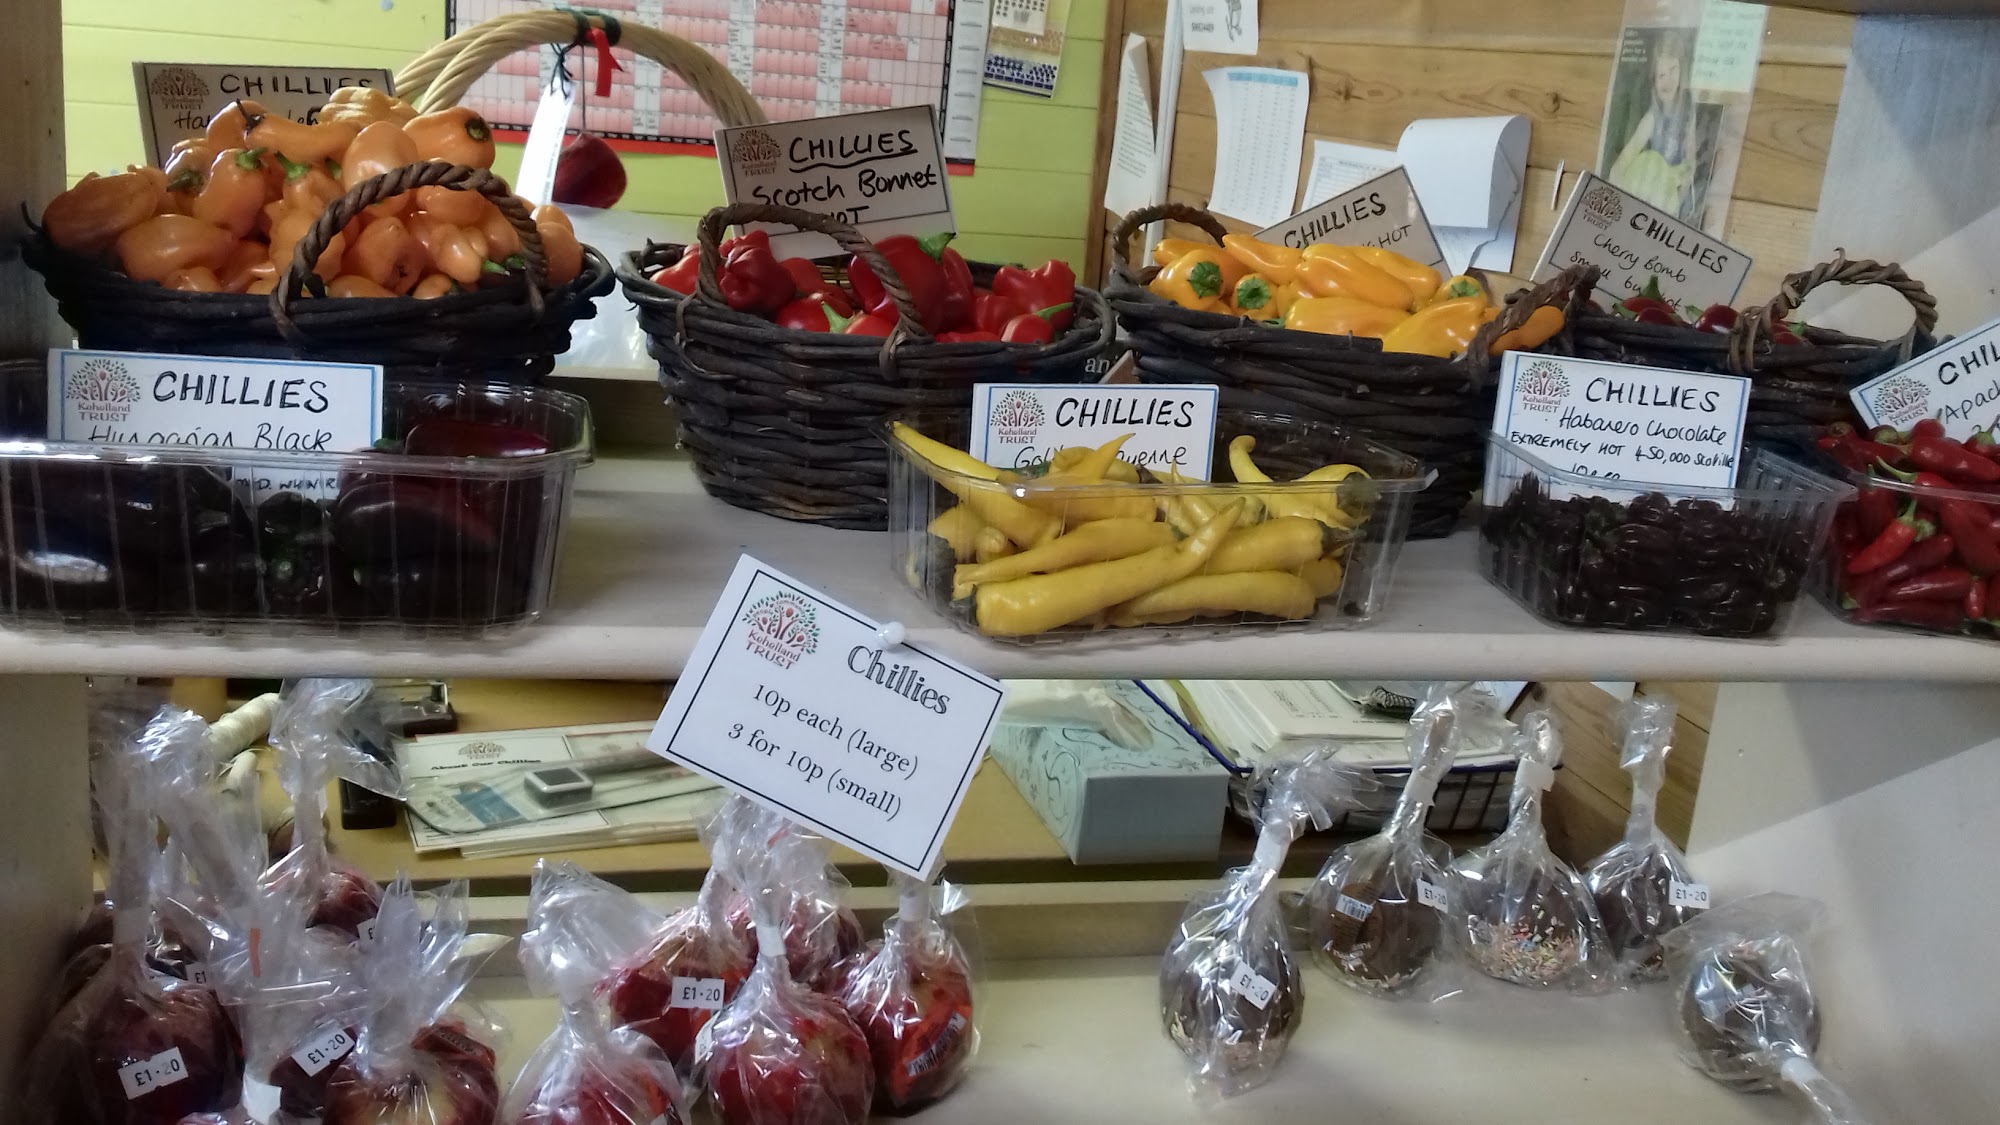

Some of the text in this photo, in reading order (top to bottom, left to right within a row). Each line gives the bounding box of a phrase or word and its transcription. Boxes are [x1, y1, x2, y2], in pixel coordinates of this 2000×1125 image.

[789, 130, 914, 163] CHILLIES
[752, 163, 938, 205] Scotch Bonnet
[830, 205, 870, 224] OT
[1284, 191, 1387, 249] CHILLIES
[1377, 223, 1412, 248] HOT
[1593, 233, 1640, 270] Cherry
[1629, 211, 1729, 274] CHILLIES
[1569, 251, 1612, 281] Smll
[152, 370, 330, 414] CHILLIES
[1523, 403, 1560, 414] TRUST
[1585, 377, 1720, 413] CHILLIES
[79, 412, 130, 422] TRUST
[1055, 396, 1195, 428] CHILLIES
[1559, 406, 1729, 446] Habanero Chocolate
[254, 422, 333, 451] Black
[999, 436, 1036, 444] TRUST
[1510, 431, 1592, 452] EXTREMELY
[1598, 442, 1626, 457] HOT
[745, 640, 796, 670] TRUST
[847, 644, 951, 714] Chillies
[752, 684, 919, 781] 10p each (large)
[728, 723, 902, 822] 3 for 10p (small)
